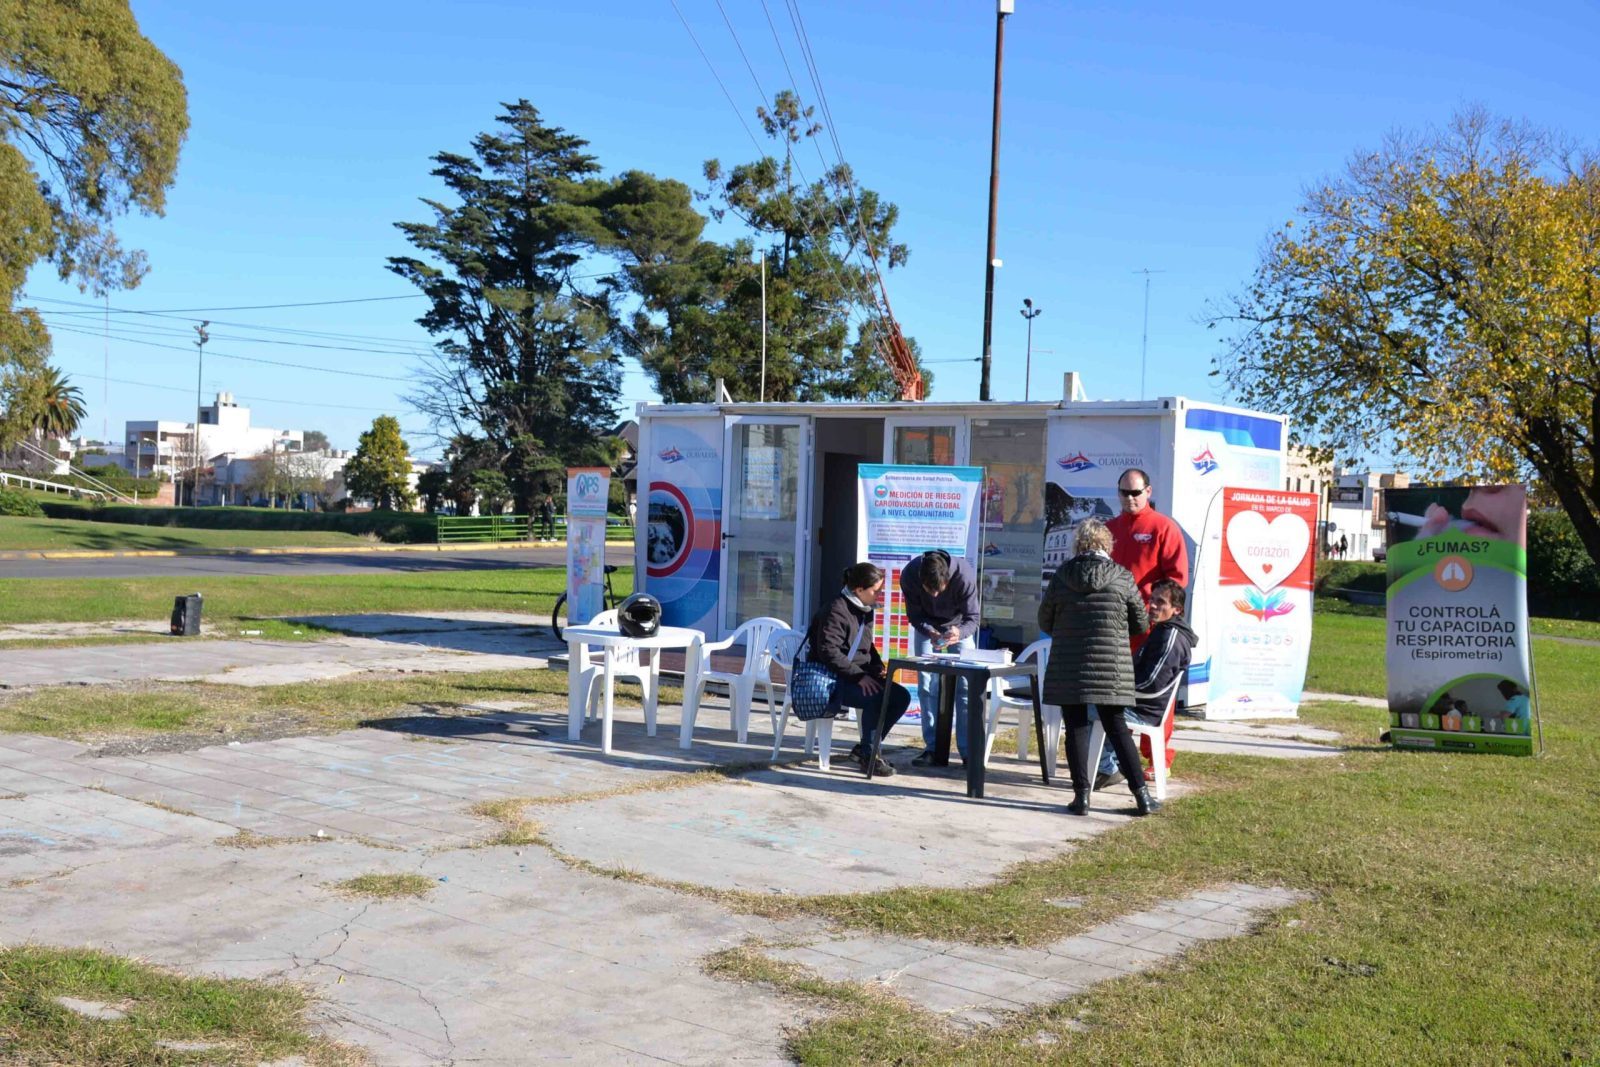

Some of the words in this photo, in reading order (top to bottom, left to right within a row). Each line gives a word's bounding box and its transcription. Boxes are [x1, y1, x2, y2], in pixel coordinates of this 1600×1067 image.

[936, 492, 961, 500] RIESGO
[1231, 492, 1265, 502] JORNADA
[1266, 494, 1276, 504] DE
[1277, 495, 1286, 504] LA
[1287, 496, 1311, 506] SALUD
[874, 500, 934, 508] CARDIOVASCULAR
[935, 501, 960, 509] GLOBAL
[908, 510, 954, 518] COMUNITARIO
[1417, 541, 1490, 556] ¿FUMAS?
[1409, 604, 1500, 619] CONTROLÁ
[1395, 620, 1416, 632] TU
[1420, 620, 1516, 633] CAPACIDAD
[1396, 634, 1516, 648] RESPIRATORIA
